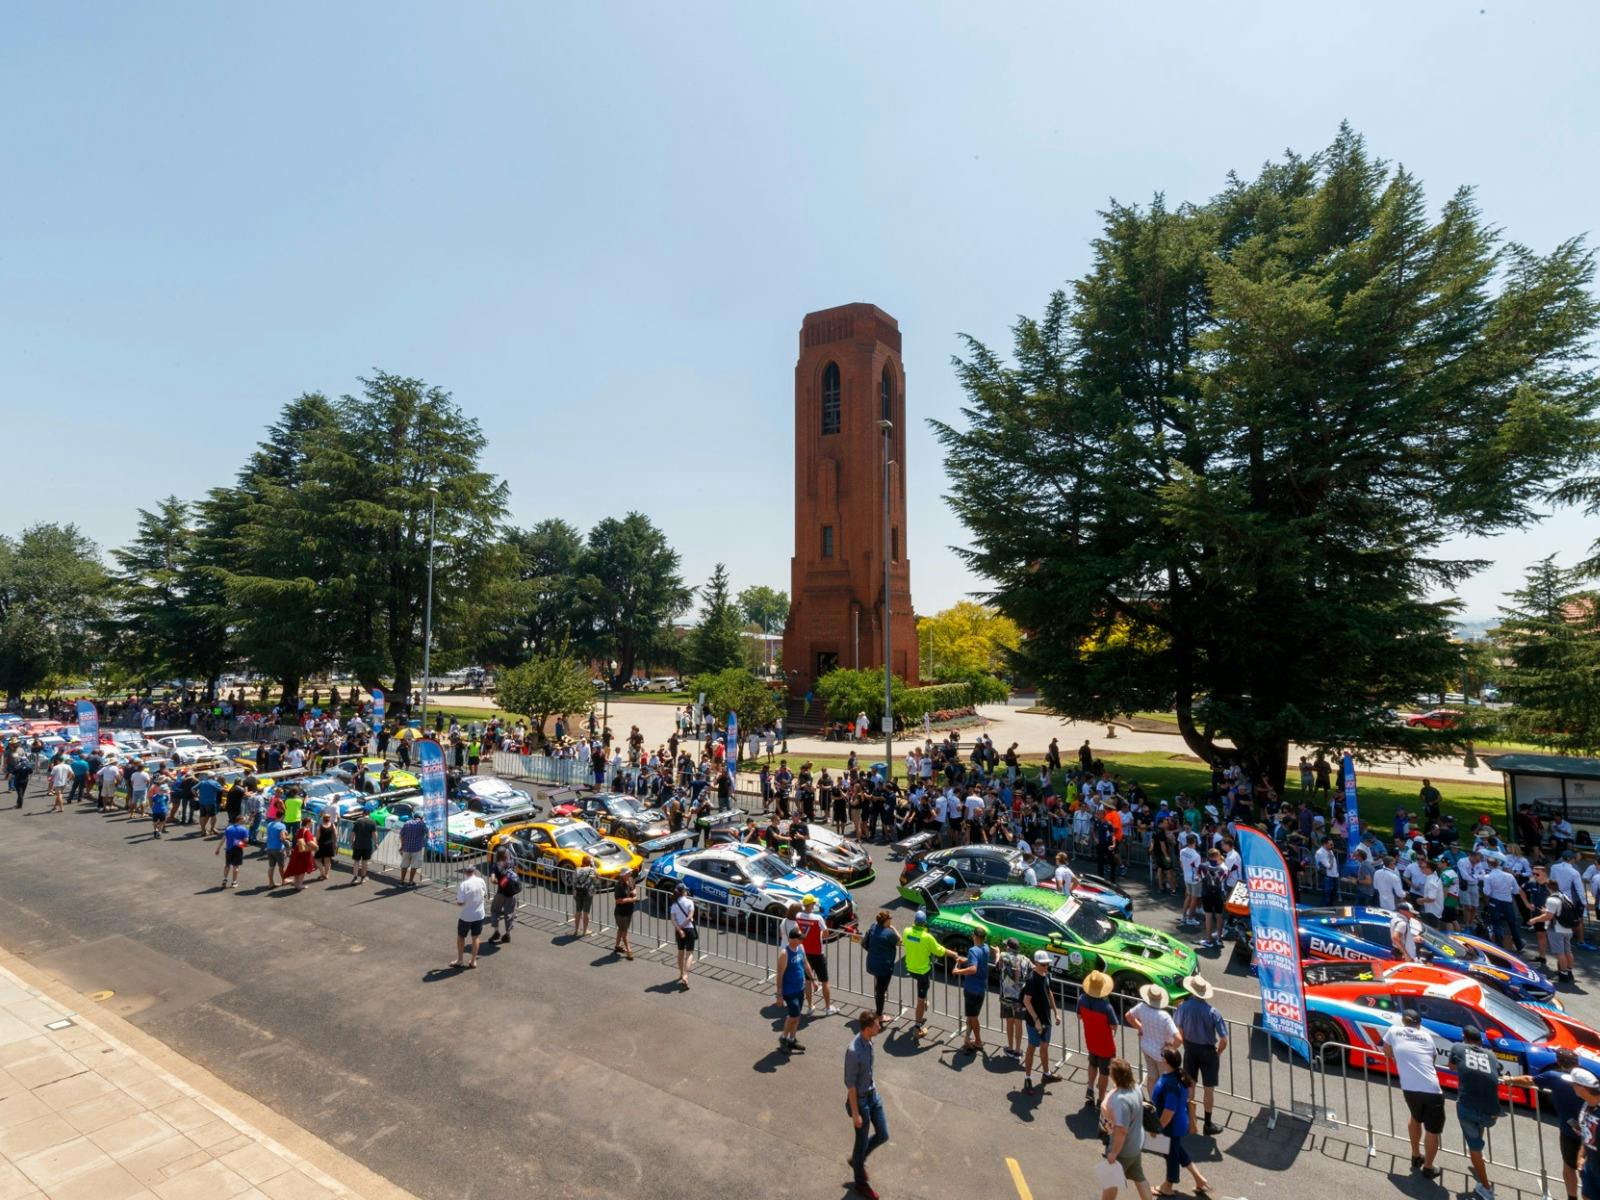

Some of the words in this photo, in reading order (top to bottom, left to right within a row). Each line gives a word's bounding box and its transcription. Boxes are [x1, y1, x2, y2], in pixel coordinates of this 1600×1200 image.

[731, 896, 742, 908] 18
[1310, 936, 1343, 957] EMA
[1053, 954, 1062, 967] 7
